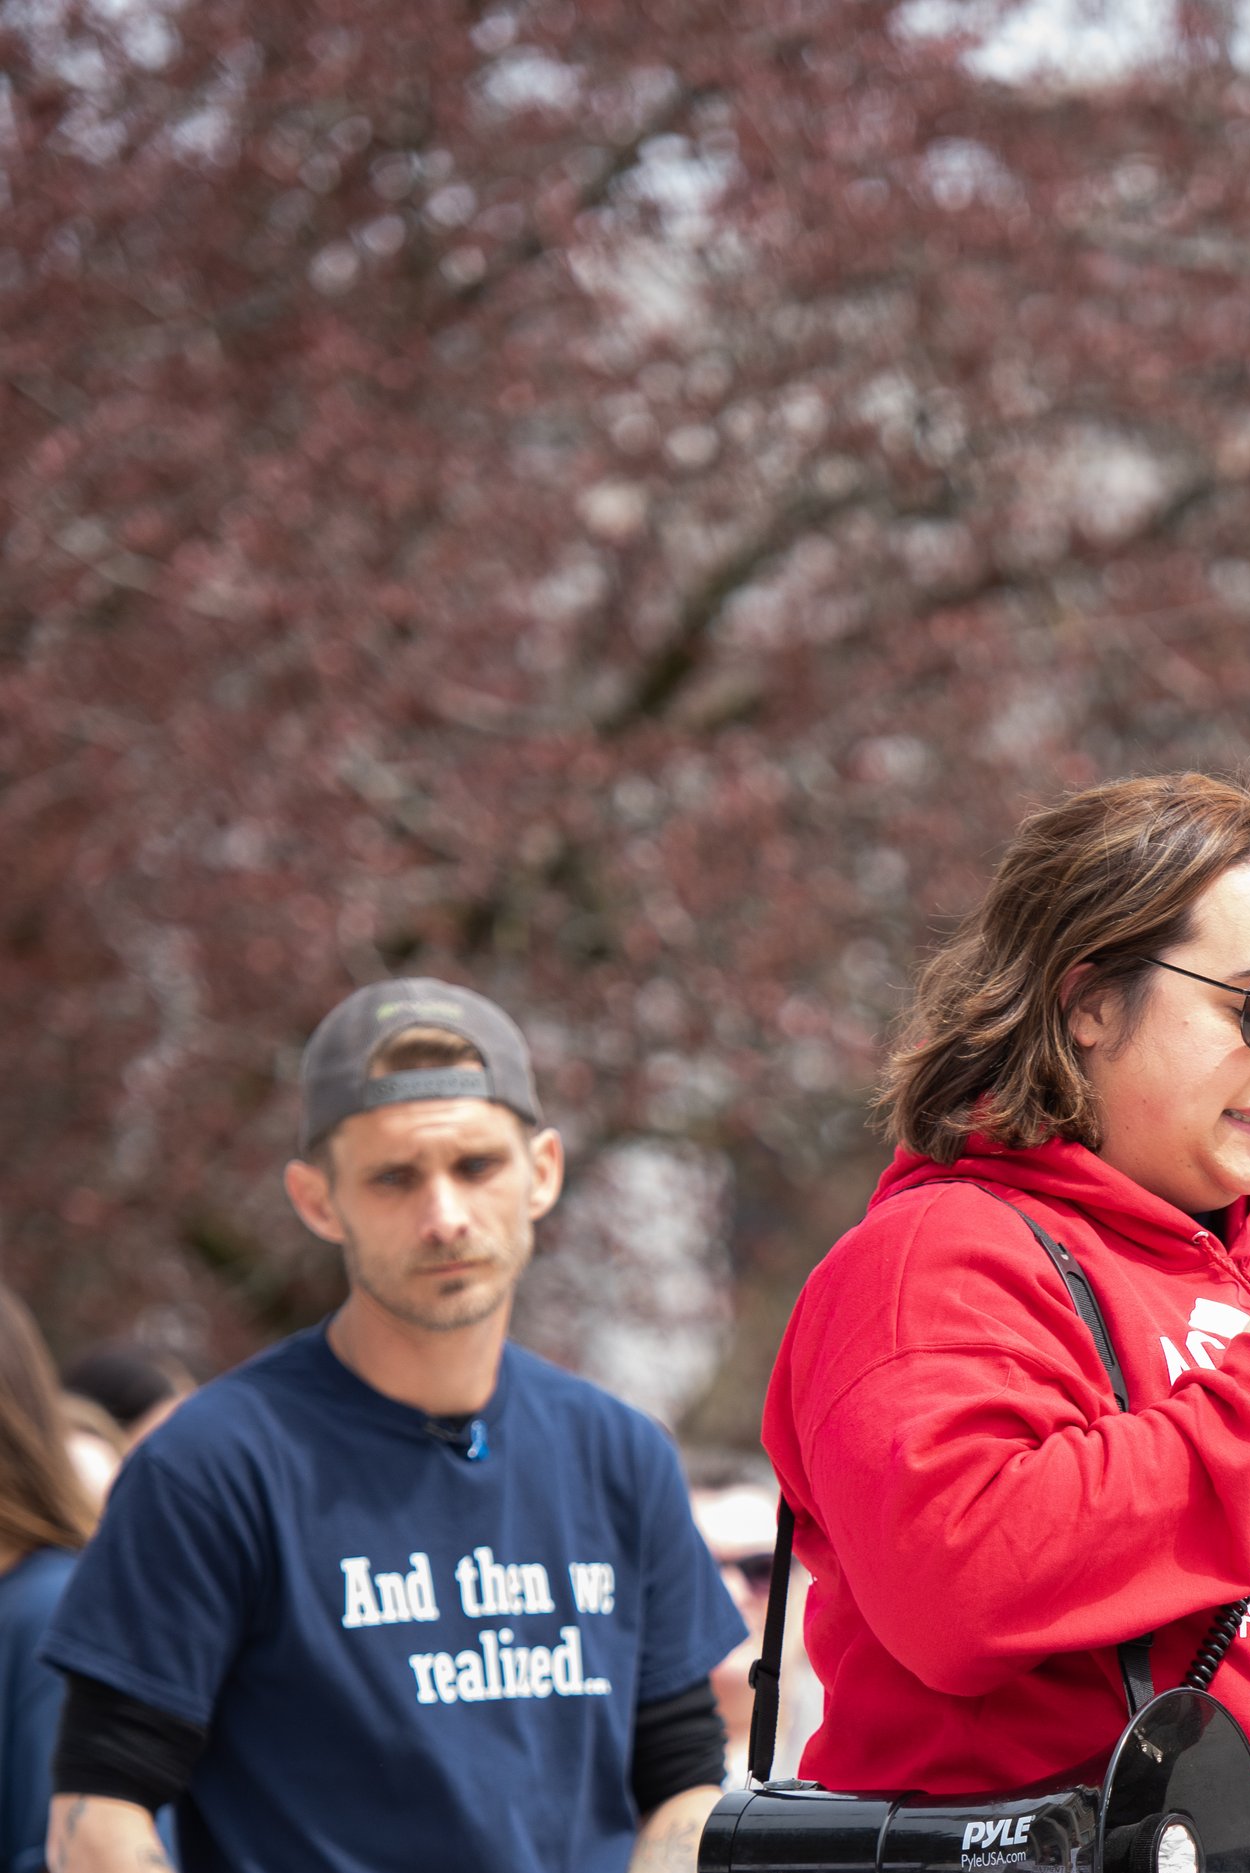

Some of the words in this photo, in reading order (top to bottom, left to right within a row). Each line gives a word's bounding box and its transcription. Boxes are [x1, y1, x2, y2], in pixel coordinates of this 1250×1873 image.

[340, 1552, 440, 1629] And
[455, 1546, 556, 1618] then
[568, 1562, 616, 1614] we
[961, 1850, 1027, 1873] PyleUSA.com
